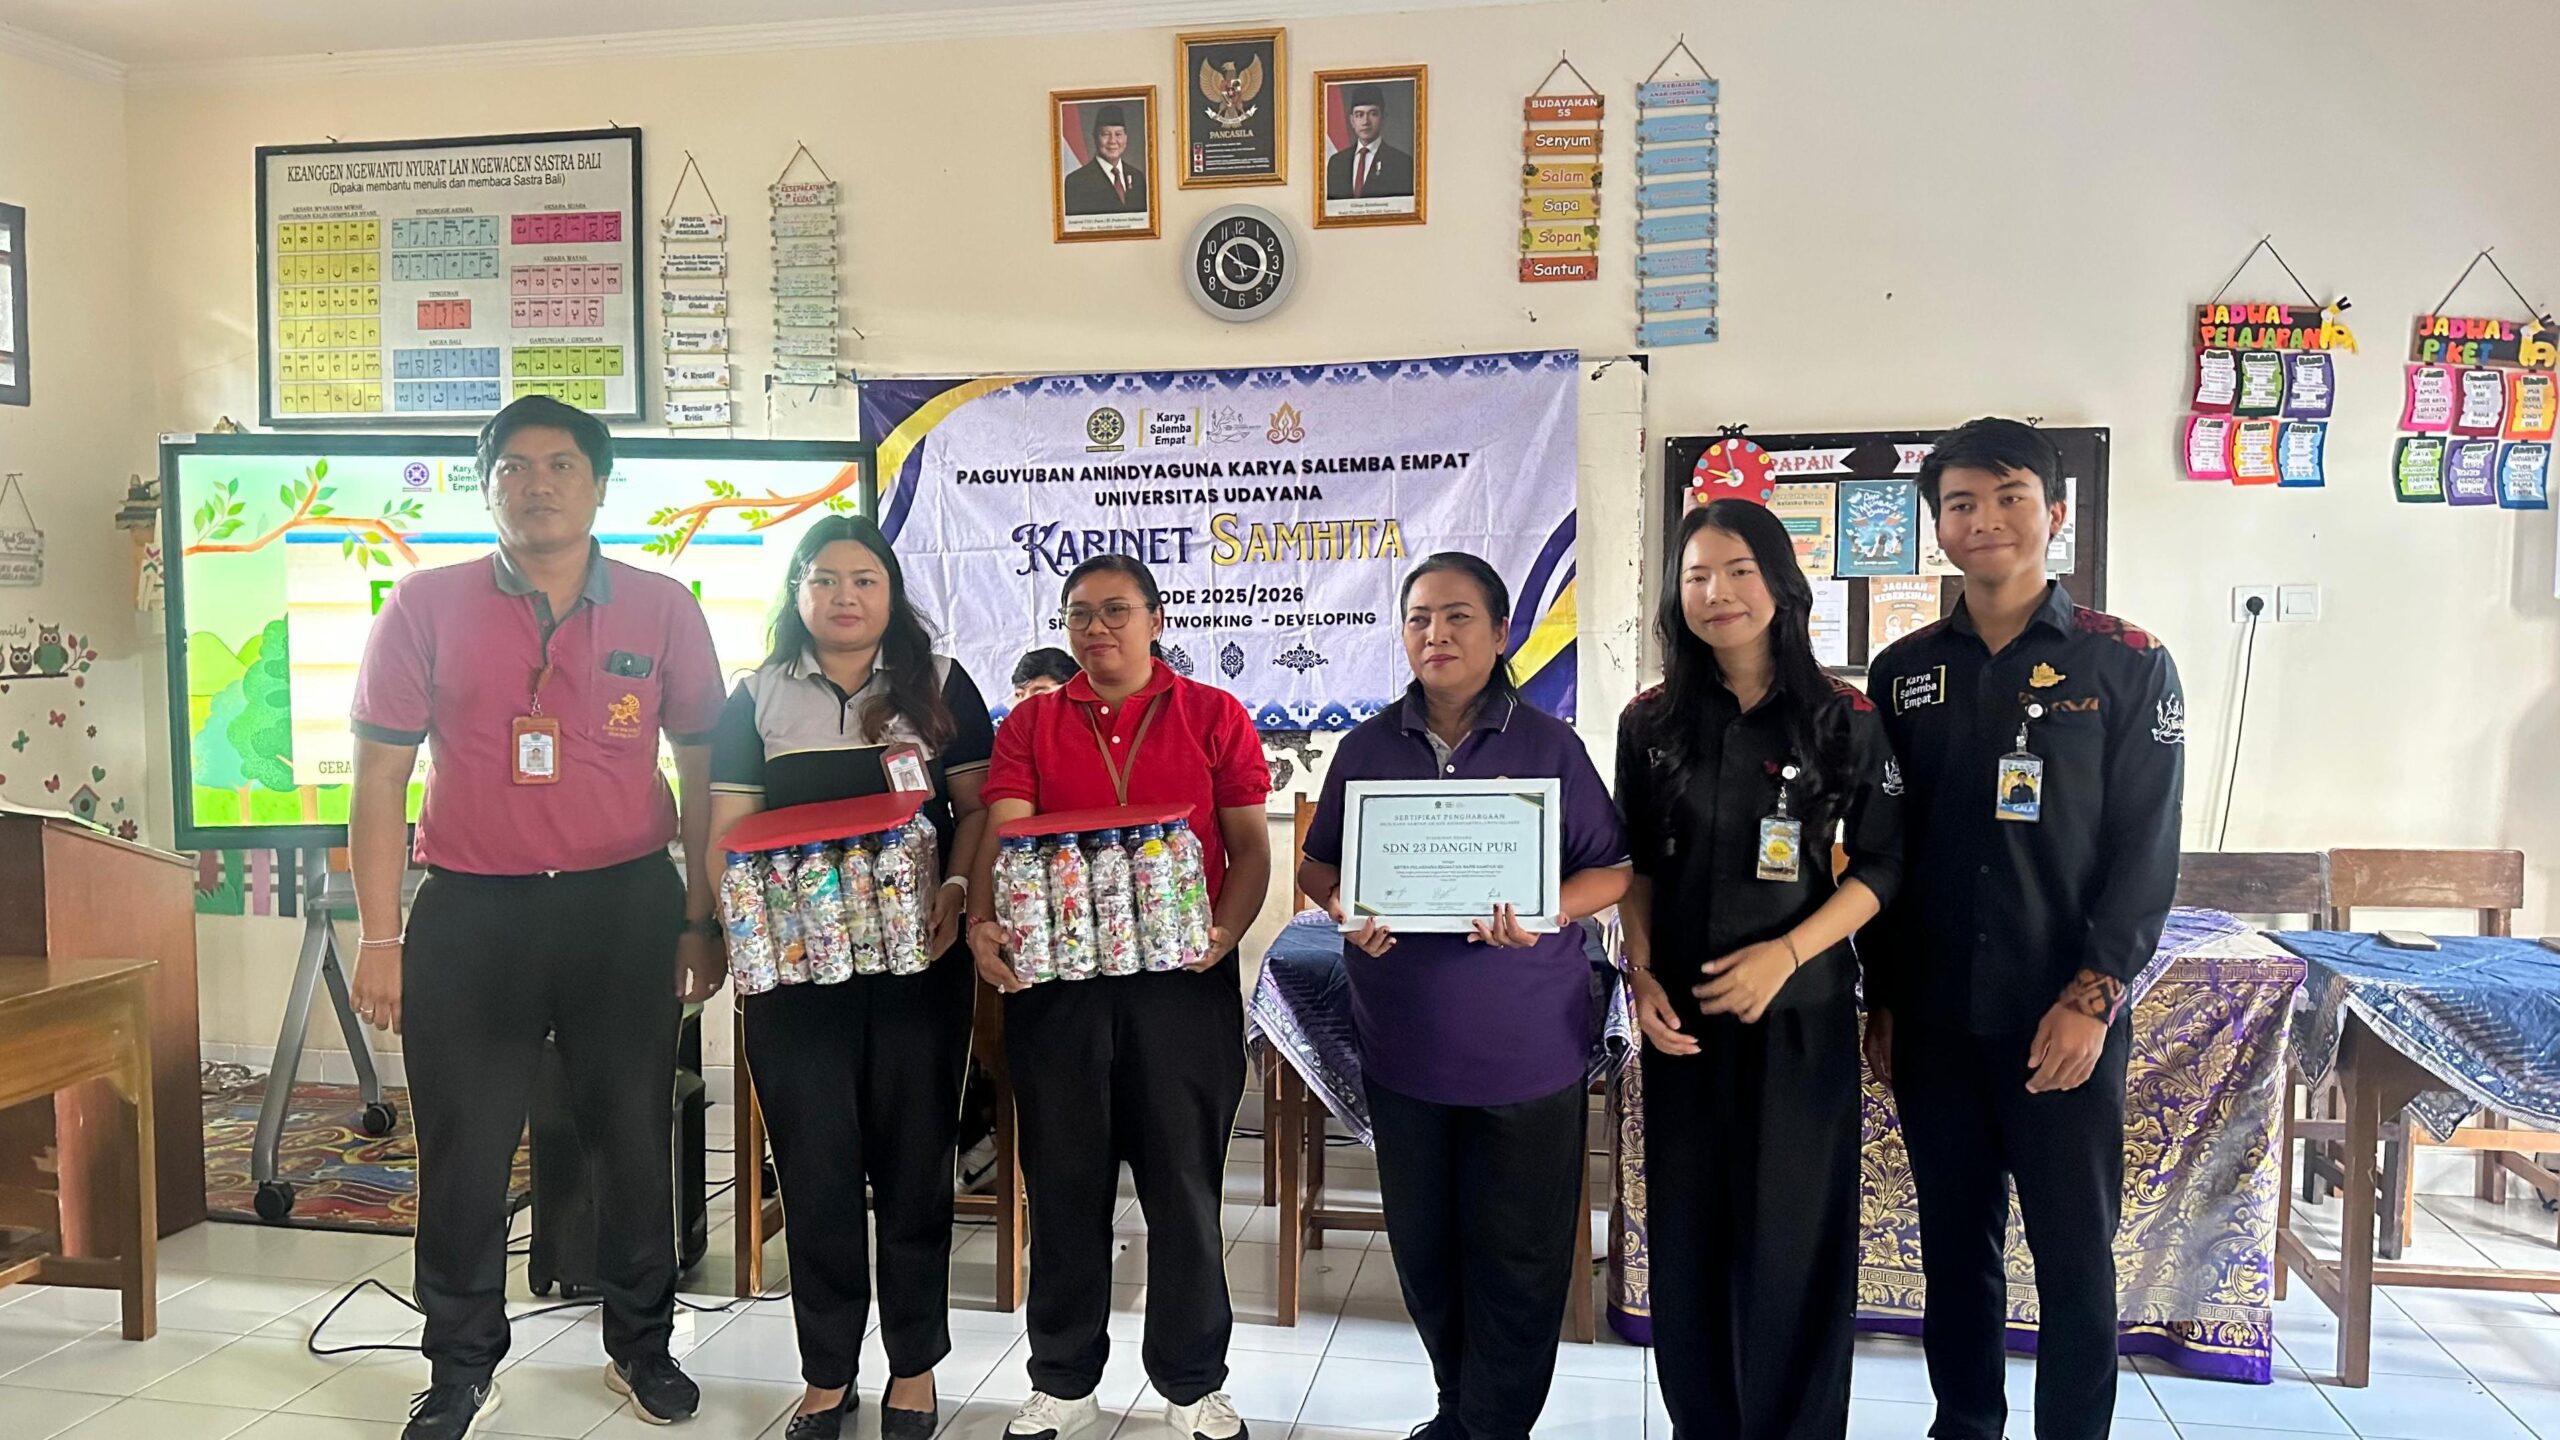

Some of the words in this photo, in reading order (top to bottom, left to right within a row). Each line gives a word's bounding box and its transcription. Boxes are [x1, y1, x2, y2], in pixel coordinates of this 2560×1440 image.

[1532, 98, 1598, 109] BUDAYAKAN
[1209, 129, 1254, 139] PANCASILA
[1535, 134, 1591, 150] Senyum
[288, 164, 344, 182] KEANGGEN
[346, 161, 403, 180] NGEWANTU
[405, 159, 447, 177] NYURAT
[449, 158, 469, 175] LAN
[471, 155, 532, 174] NGEWACEN
[534, 153, 575, 172] SASTRA
[577, 152, 602, 169] BALI
[329, 182, 364, 195] (Dipakai
[366, 180, 411, 192] membantu
[413, 178, 447, 190] menulis
[449, 177, 466, 189] dan
[468, 176, 511, 187] membaca
[513, 174, 542, 186] Sastra
[545, 173, 565, 186] Bali)
[1541, 170, 1584, 183] Salam
[1543, 200, 1579, 215] Sapa
[1221, 226, 1228, 241] 11
[1235, 220, 1246, 235] 12
[1256, 224, 1260, 239] 1
[1266, 237, 1274, 252] 2
[1538, 231, 1581, 246] Sopan
[1207, 240, 1217, 255] 10
[1203, 258, 1211, 273] 9
[1272, 255, 1280, 270] 3
[1533, 264, 1584, 276] Santun
[1208, 276, 1216, 291] 8
[1266, 274, 1274, 288] 4
[1221, 289, 1229, 304] 7
[1238, 293, 1246, 308] 6
[1255, 287, 1263, 302] 5
[2200, 303, 2294, 325] JADWAL
[2420, 315, 2516, 341] JADWAL
[2201, 326, 2321, 349] PELAJARAN
[2422, 338, 2494, 365] PIKET
[690, 371, 715, 379] Kreatif
[682, 404, 712, 412] Bernalar
[1156, 412, 1186, 424] Karya
[1150, 423, 1192, 434] Salemba
[1155, 435, 1186, 446] Empat
[1771, 454, 1834, 472] PAPAN
[1904, 450, 1926, 464] PA
[453, 464, 472, 474] Kary
[956, 467, 1075, 485] PAGUYUBAN
[1080, 462, 1223, 482] ANINDYAGUNA
[1228, 459, 1296, 477] KARYA
[1301, 456, 1396, 474] SALEMBA
[1401, 453, 1470, 471] EMPAT
[448, 473, 478, 482] Salemb
[452, 483, 478, 492] Empat
[1095, 488, 1218, 507] UNIVERSITAS
[1224, 485, 1323, 503] UDAYANA
[1011, 520, 1194, 577] KABINET
[1210, 512, 1408, 567] SAMHITA
[1159, 589, 1196, 605] ODE
[1201, 584, 1304, 607] 2025/2026
[1164, 615, 1253, 629] TWORKING
[1274, 612, 1377, 627] DEVELOPING
[0, 623, 27, 638] mily
[1905, 673, 1931, 687] Karya
[1900, 682, 1937, 700] Salemba
[1904, 693, 1932, 710] Empat
[318, 760, 351, 774] GERA
[2012, 804, 2035, 813] GALA
[1382, 843, 1409, 853] SDN
[1412, 843, 1426, 853] 23
[1430, 842, 1482, 853] DANGIN
[1487, 842, 1518, 852] PURI
